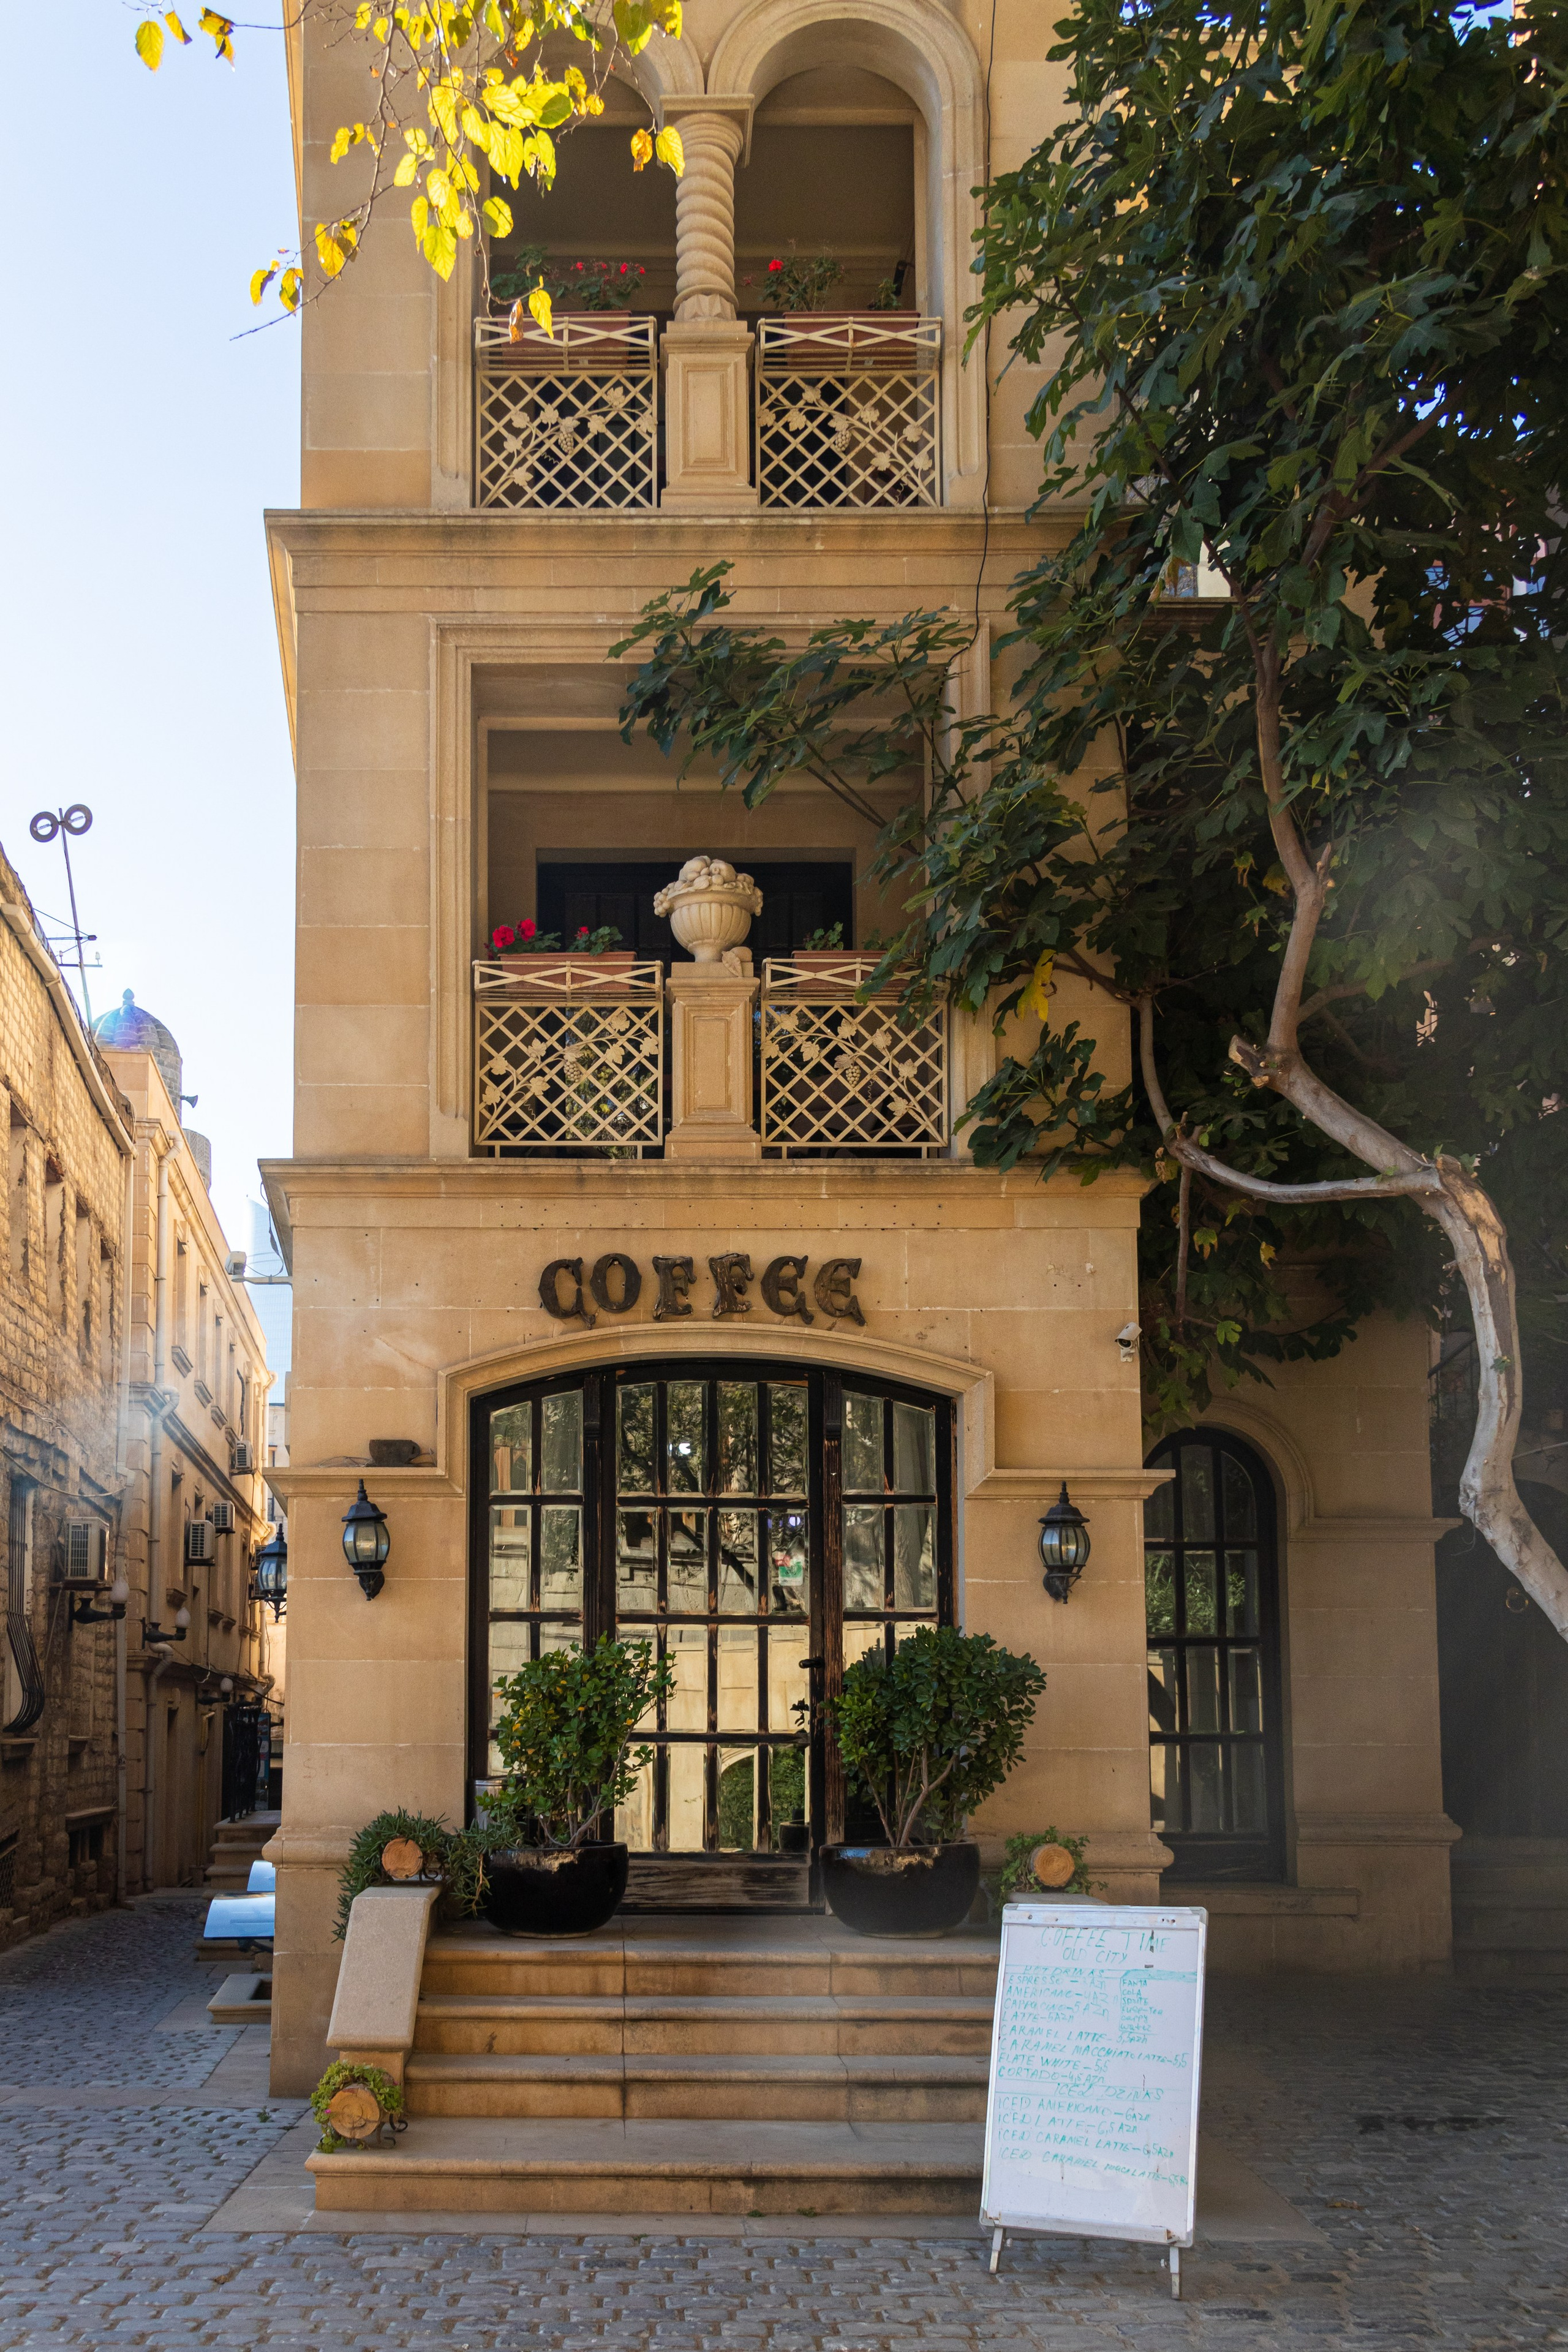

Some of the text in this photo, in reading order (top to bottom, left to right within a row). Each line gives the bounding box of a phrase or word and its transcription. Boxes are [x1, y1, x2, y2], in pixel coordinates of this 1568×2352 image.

[538, 1253, 867, 1329] COFFEE
[1041, 1928, 1171, 1953] COFFEE TIME
[1063, 1947, 1087, 1961] OLD
[1122, 1979, 1148, 1989] FANTA
[1001, 2024, 1060, 2038] CARAMEL
[1000, 2038, 1067, 2052] CARAMEL
[998, 2052, 1035, 2065] FLATE
[1041, 2056, 1081, 2070] WHITE
[998, 2097, 1031, 2111] ICED
[1036, 2132, 1089, 2146] CARAMEL
[1042, 2151, 1098, 2168] CARAMEL
